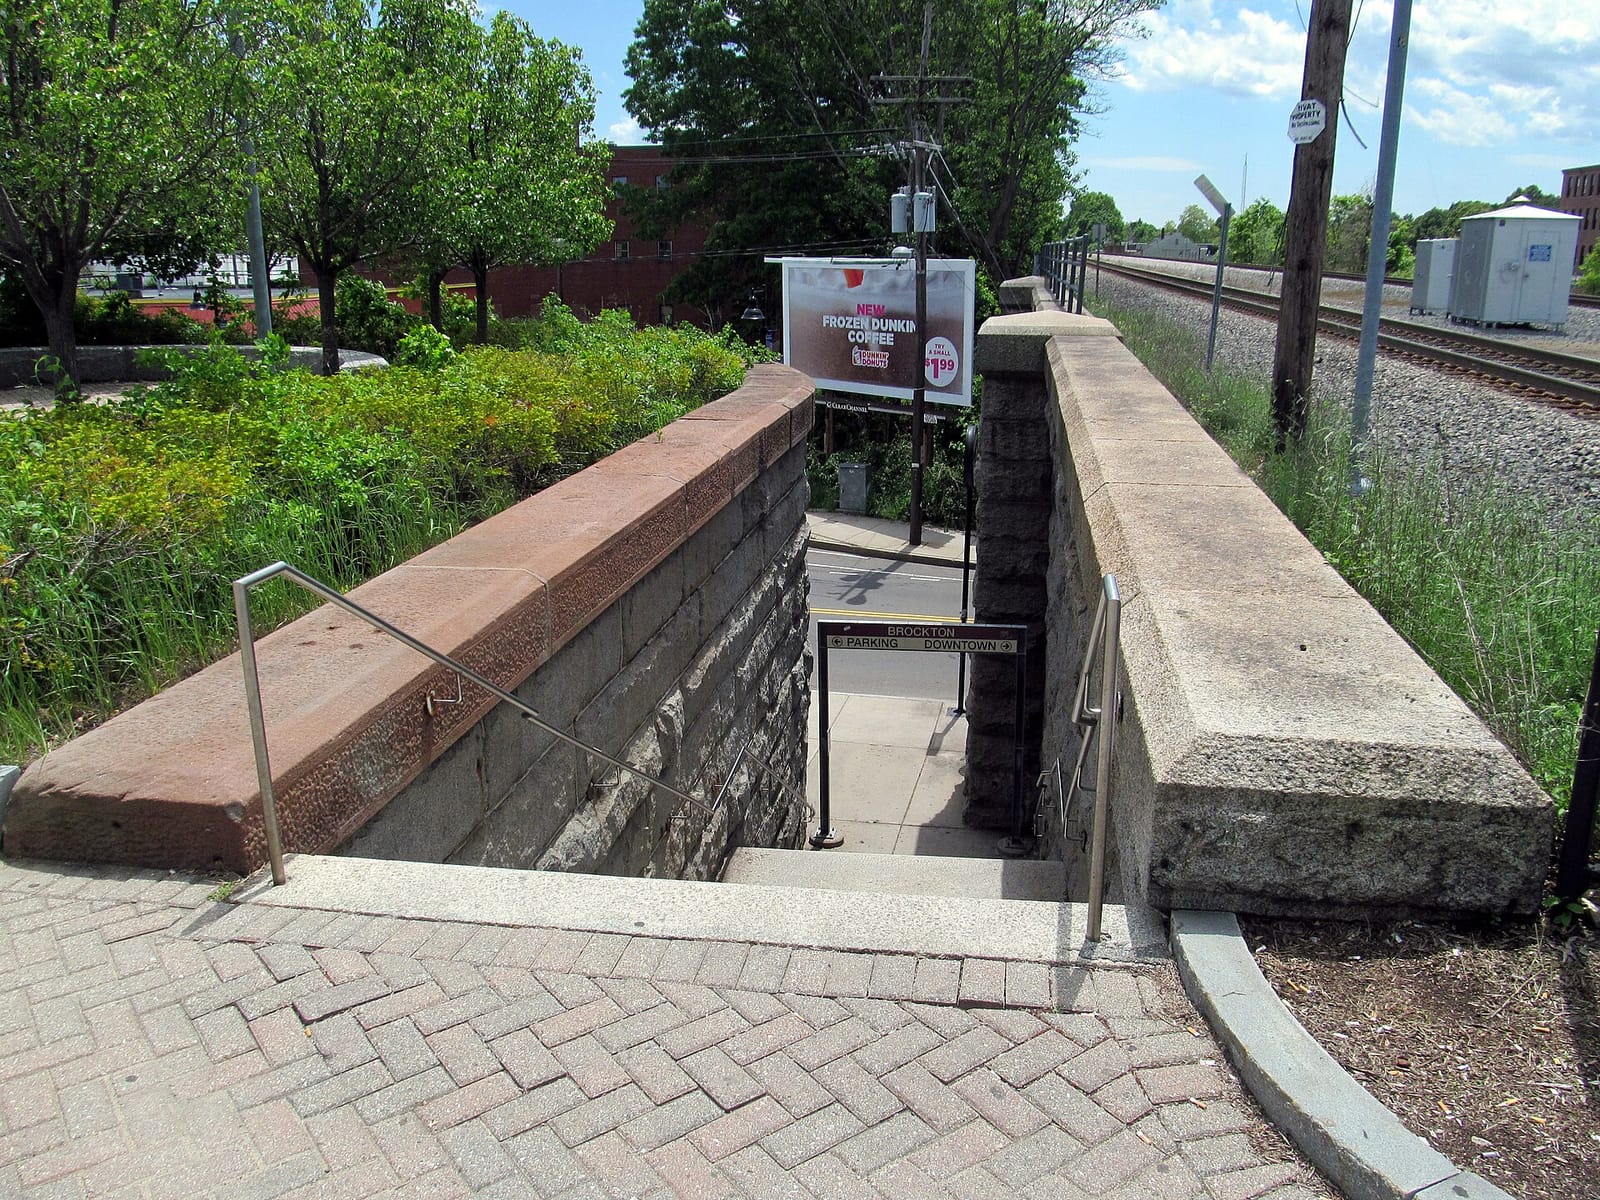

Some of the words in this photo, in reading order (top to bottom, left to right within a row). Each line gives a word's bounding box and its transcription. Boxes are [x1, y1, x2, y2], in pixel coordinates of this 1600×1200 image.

[857, 304, 885, 316] NEW
[822, 315, 869, 330] FROZEN
[847, 330, 894, 346] COFFEE
[863, 359, 887, 367] DONUTS
[887, 626, 955, 638] BROCKTON
[847, 637, 898, 648] PARKING
[924, 639, 997, 651] DOWNTOWN
